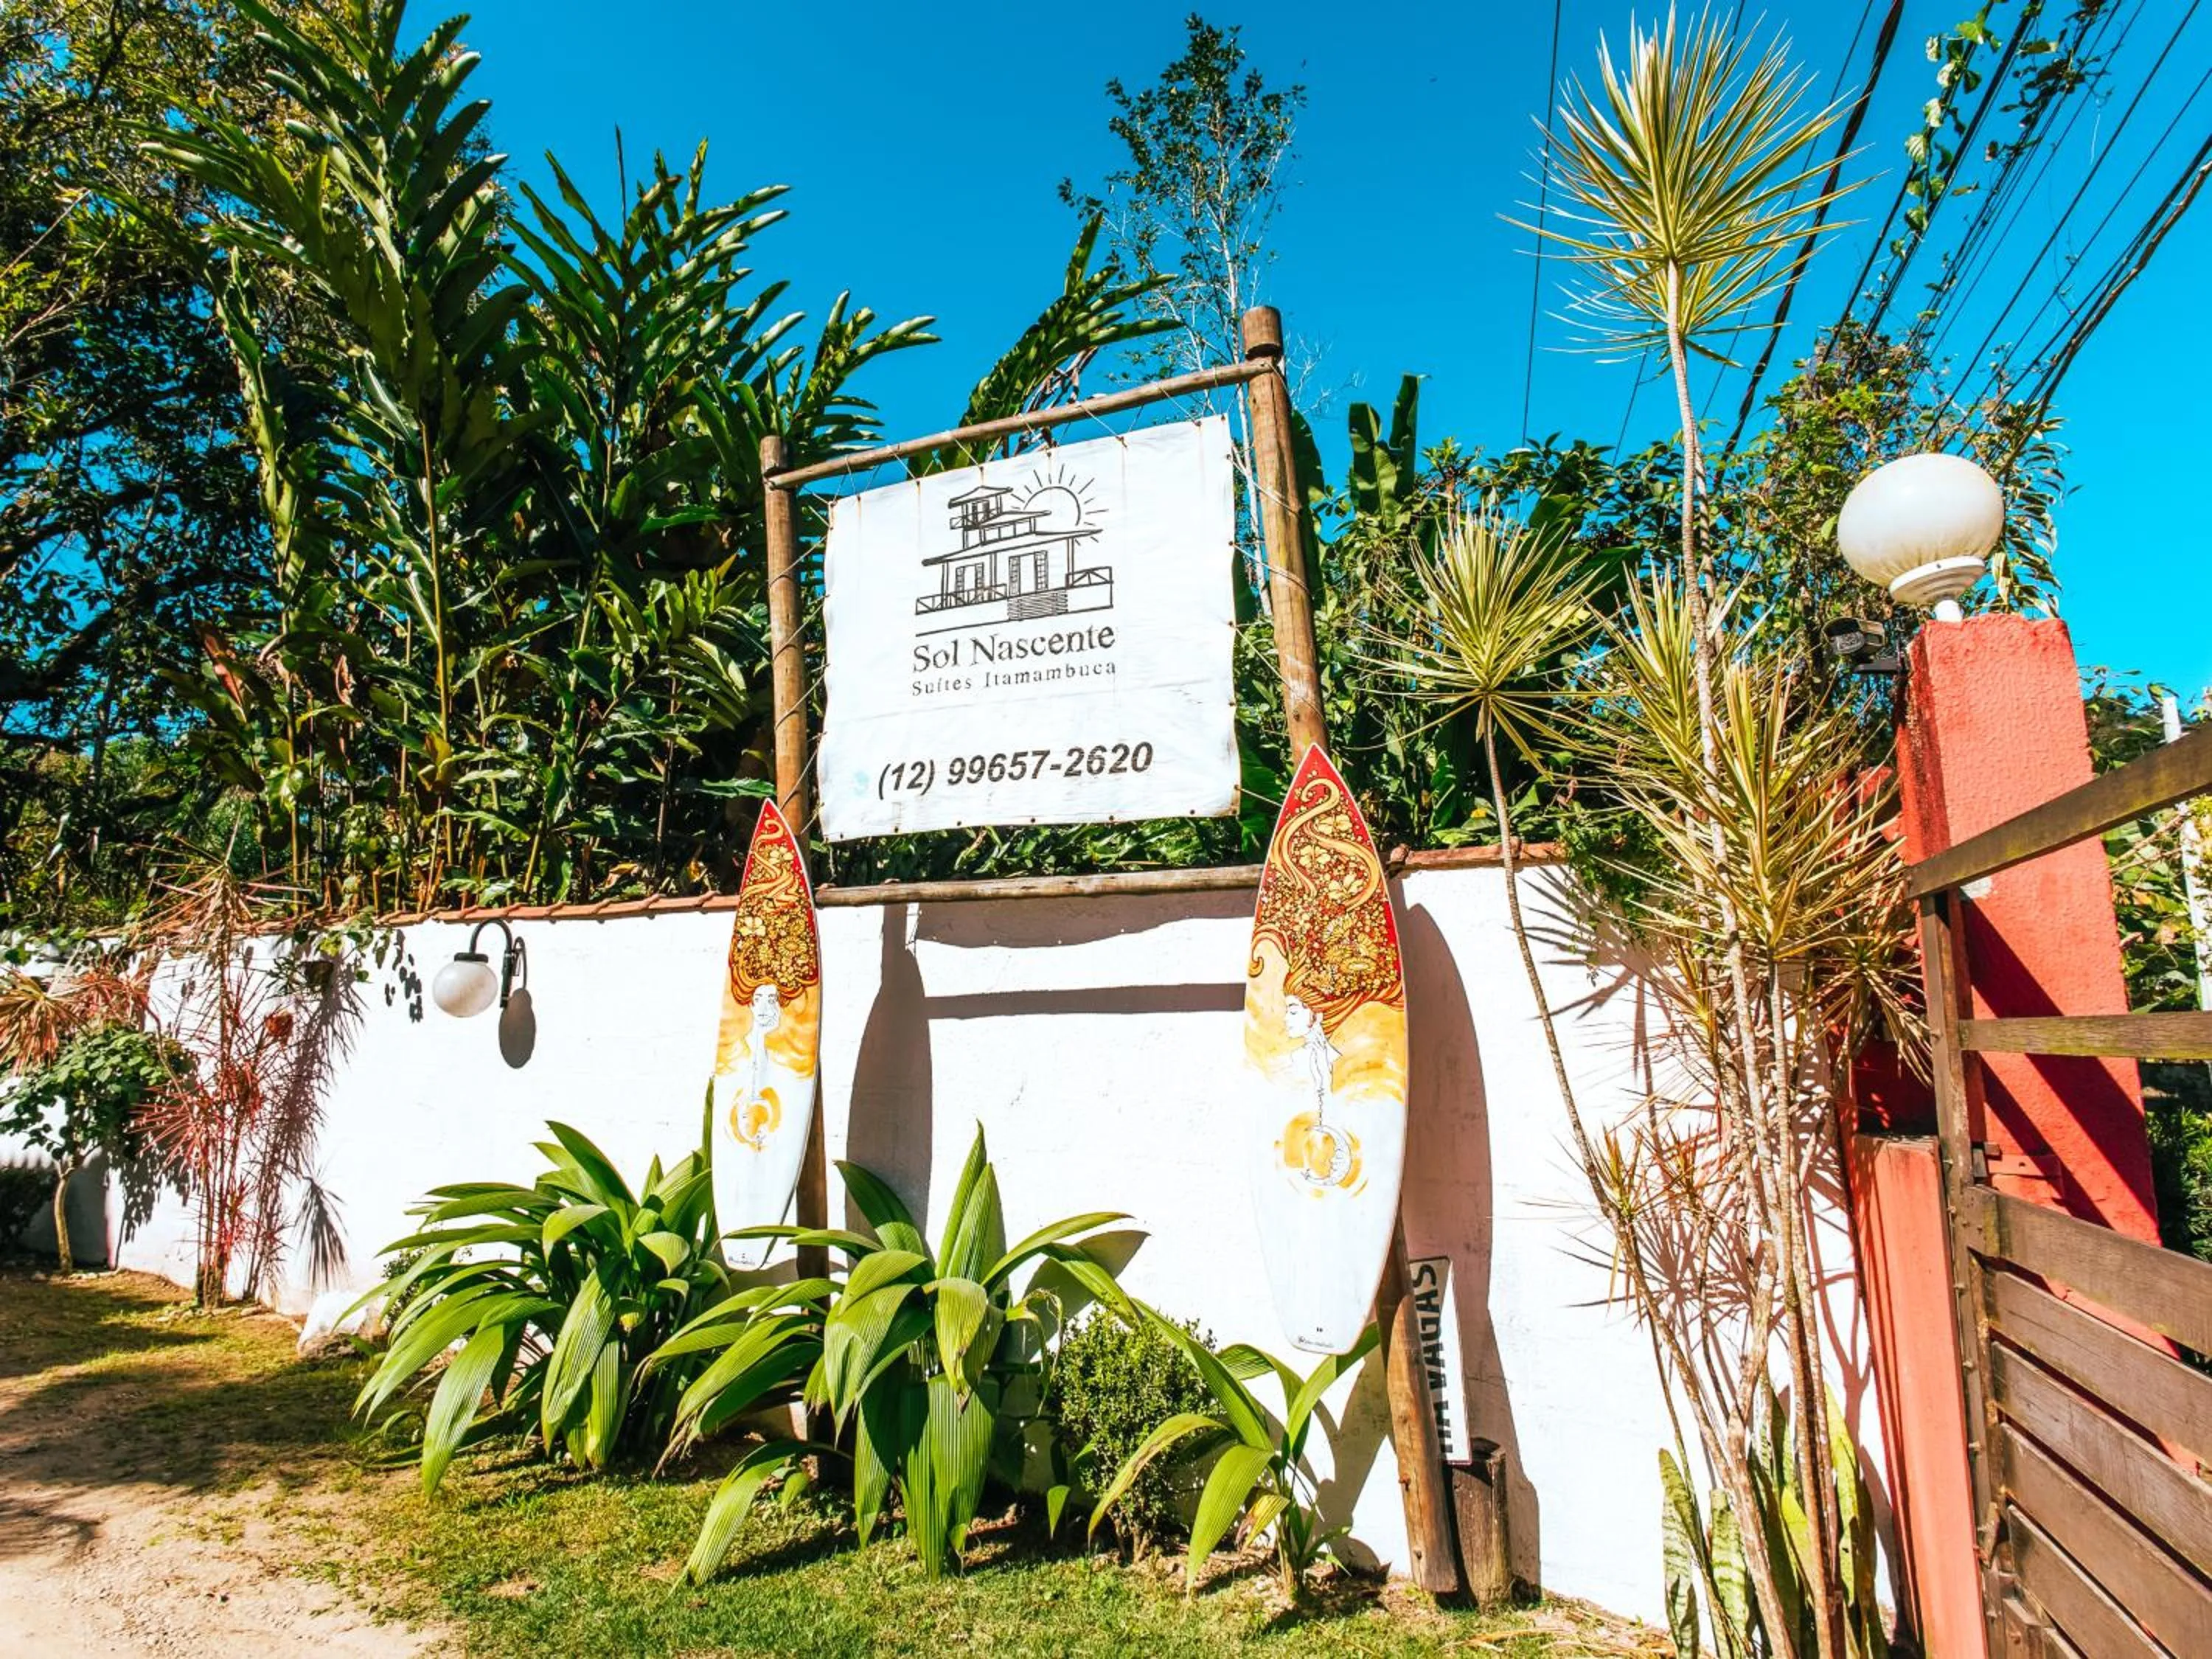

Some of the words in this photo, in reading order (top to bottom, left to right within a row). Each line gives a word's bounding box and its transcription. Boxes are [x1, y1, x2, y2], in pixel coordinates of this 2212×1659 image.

[913, 639, 959, 672] Sol
[970, 625, 1116, 667] Nascente
[984, 662, 1116, 688] Itamambuca
[878, 759, 936, 801] (12)
[947, 741, 1154, 787] 99657-2620
